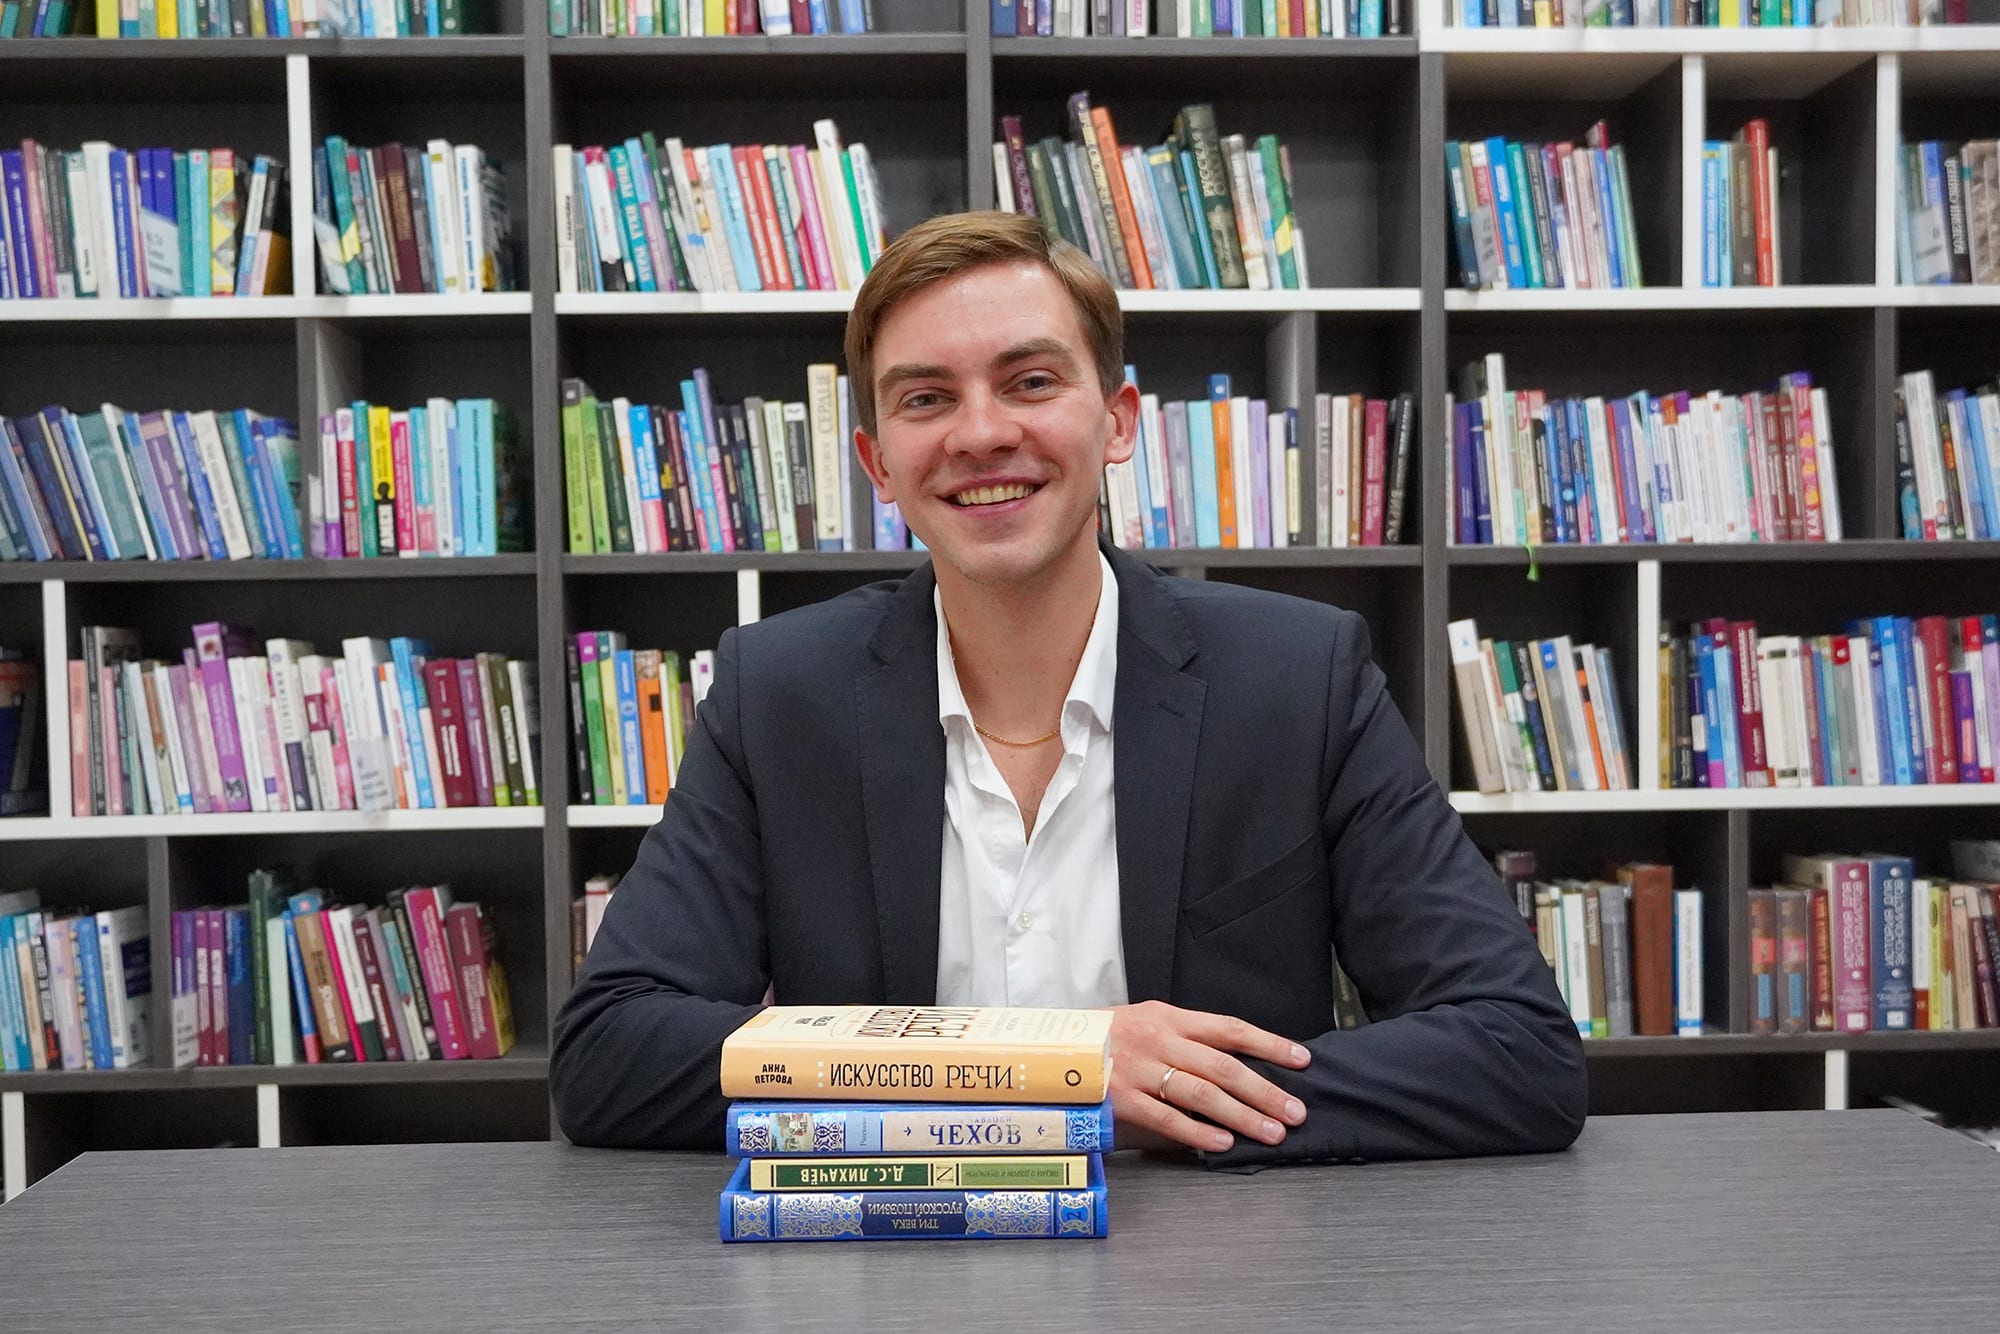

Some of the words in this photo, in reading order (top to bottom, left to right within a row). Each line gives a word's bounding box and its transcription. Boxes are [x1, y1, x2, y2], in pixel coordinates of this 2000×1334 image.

[815, 372, 833, 434] СЕРДЦЕ
[1842, 881, 1853, 907] ДЛЯ
[1883, 880, 1894, 906] ДЛЯ
[1853, 881, 1865, 968] ЭКОНОМИСТОВ
[1893, 879, 1905, 966] ЭКОНОМИСТОВ
[1843, 909, 1854, 968] ИСТОРИЯ
[1884, 908, 1895, 967] ИСТОРИЯ
[755, 1074, 793, 1085] ПЕТРОВА
[762, 1063, 786, 1074] АННА
[830, 1063, 934, 1088] ИСКУССТВО
[945, 1064, 1015, 1090] РЕЧИ
[928, 1123, 1022, 1146] ЧЕХОВ
[801, 1167, 869, 1185] ЛИХАЧЁВ
[873, 1165, 904, 1182] Д.С.
[868, 1202, 914, 1216] ПОЭЗИИ
[915, 1202, 963, 1218] РУССКОЙ
[893, 1218, 916, 1230] ВЕКА
[917, 1218, 940, 1230] ТРИ
